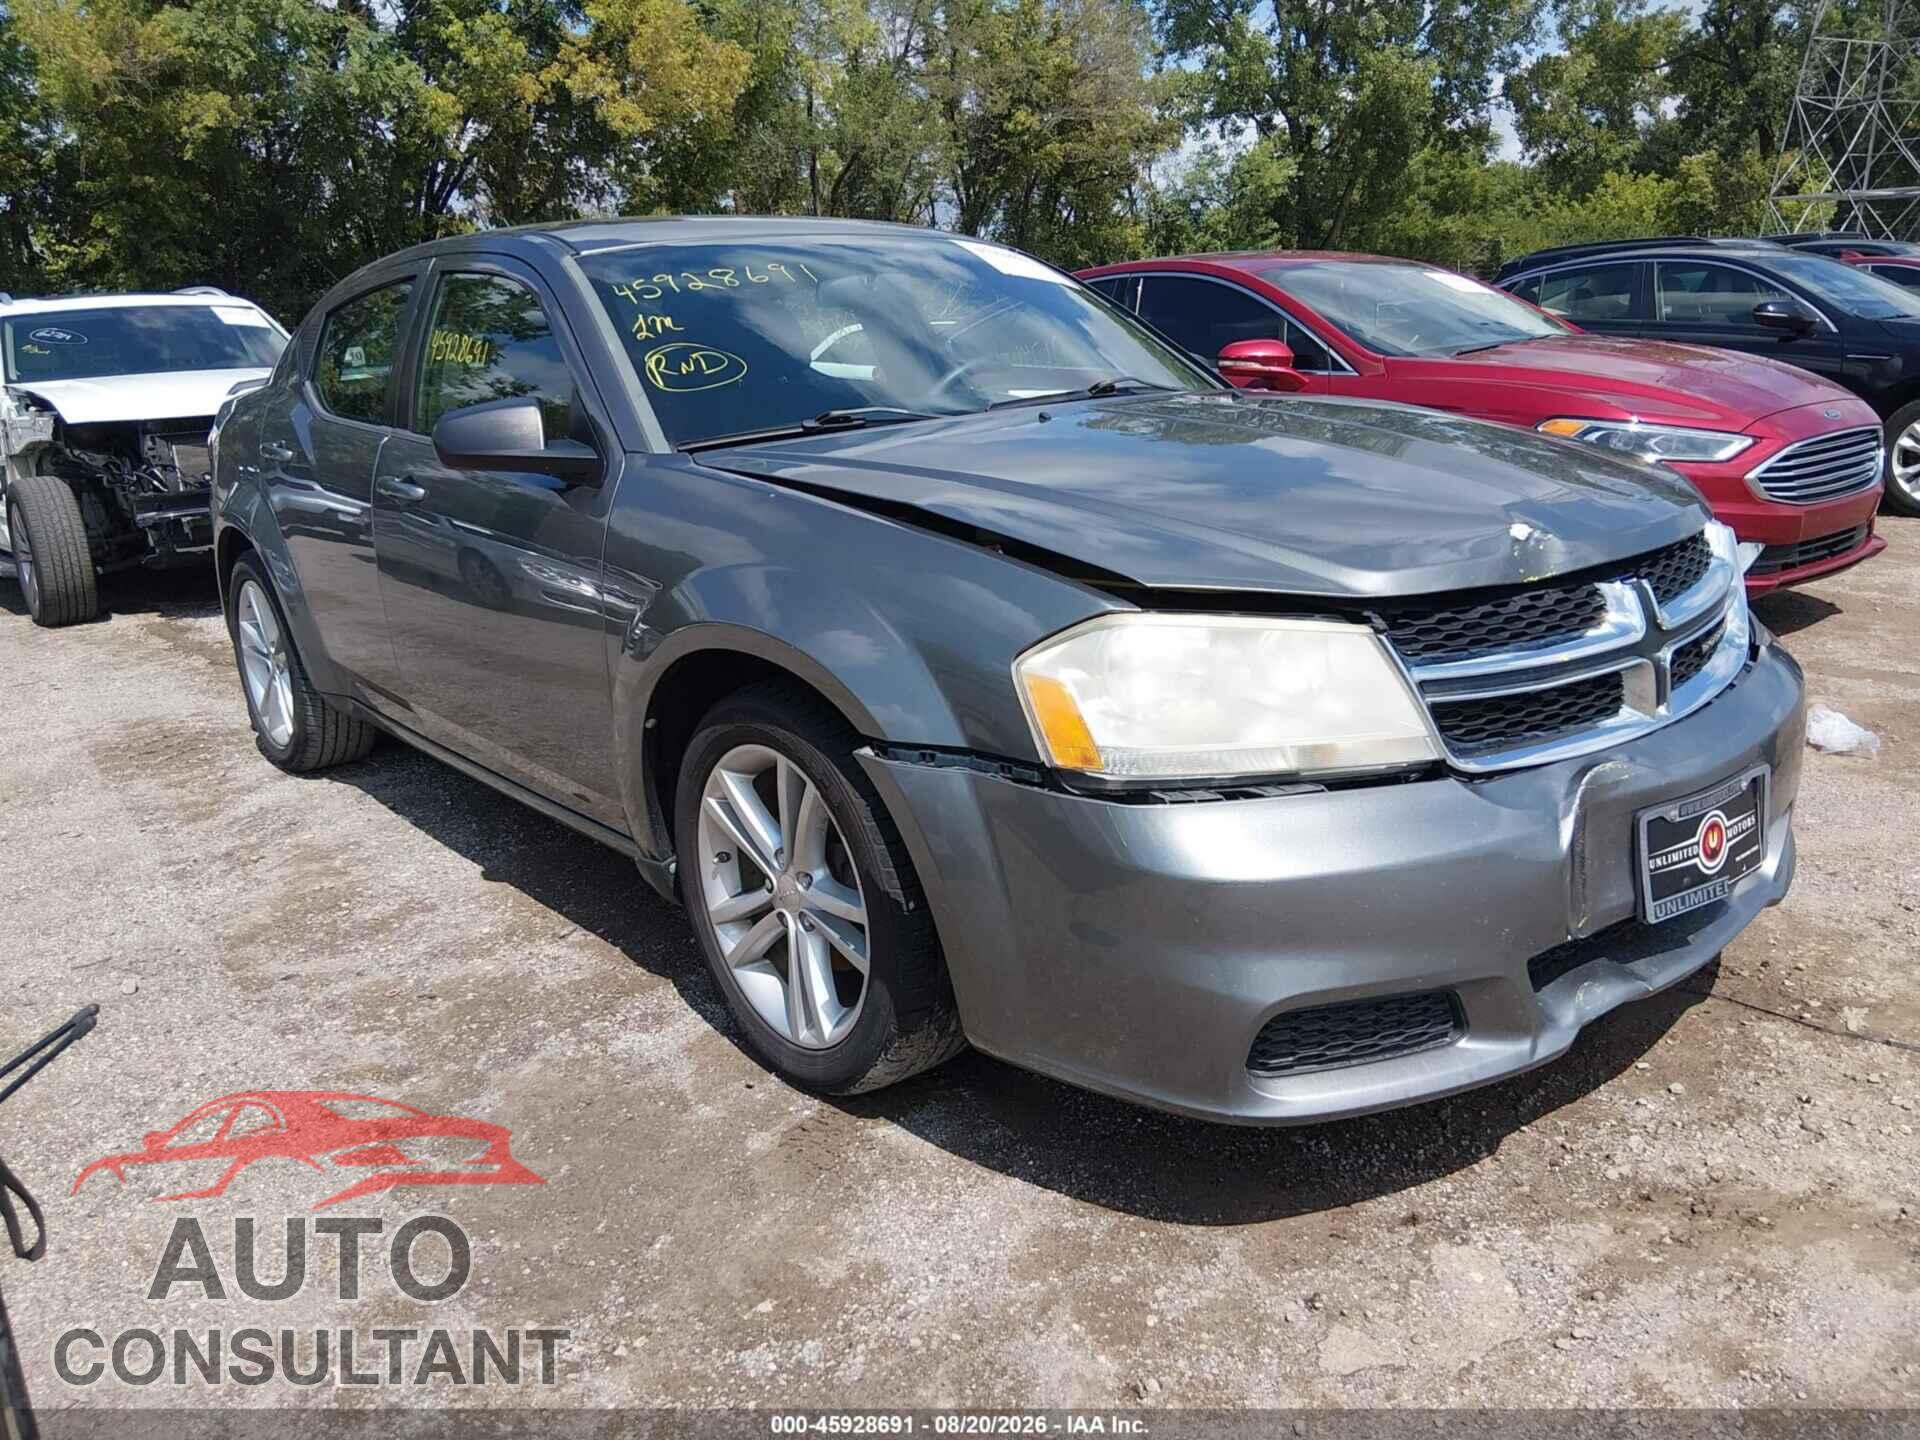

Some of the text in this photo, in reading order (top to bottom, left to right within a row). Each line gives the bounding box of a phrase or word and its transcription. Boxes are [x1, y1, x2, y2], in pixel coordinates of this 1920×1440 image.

[611, 263, 818, 304] 45928691
[431, 329, 489, 368] 45928691
[648, 351, 728, 387] RND
[1649, 847, 1699, 869] UNLIMITED
[1726, 814, 1756, 838] MOTORS
